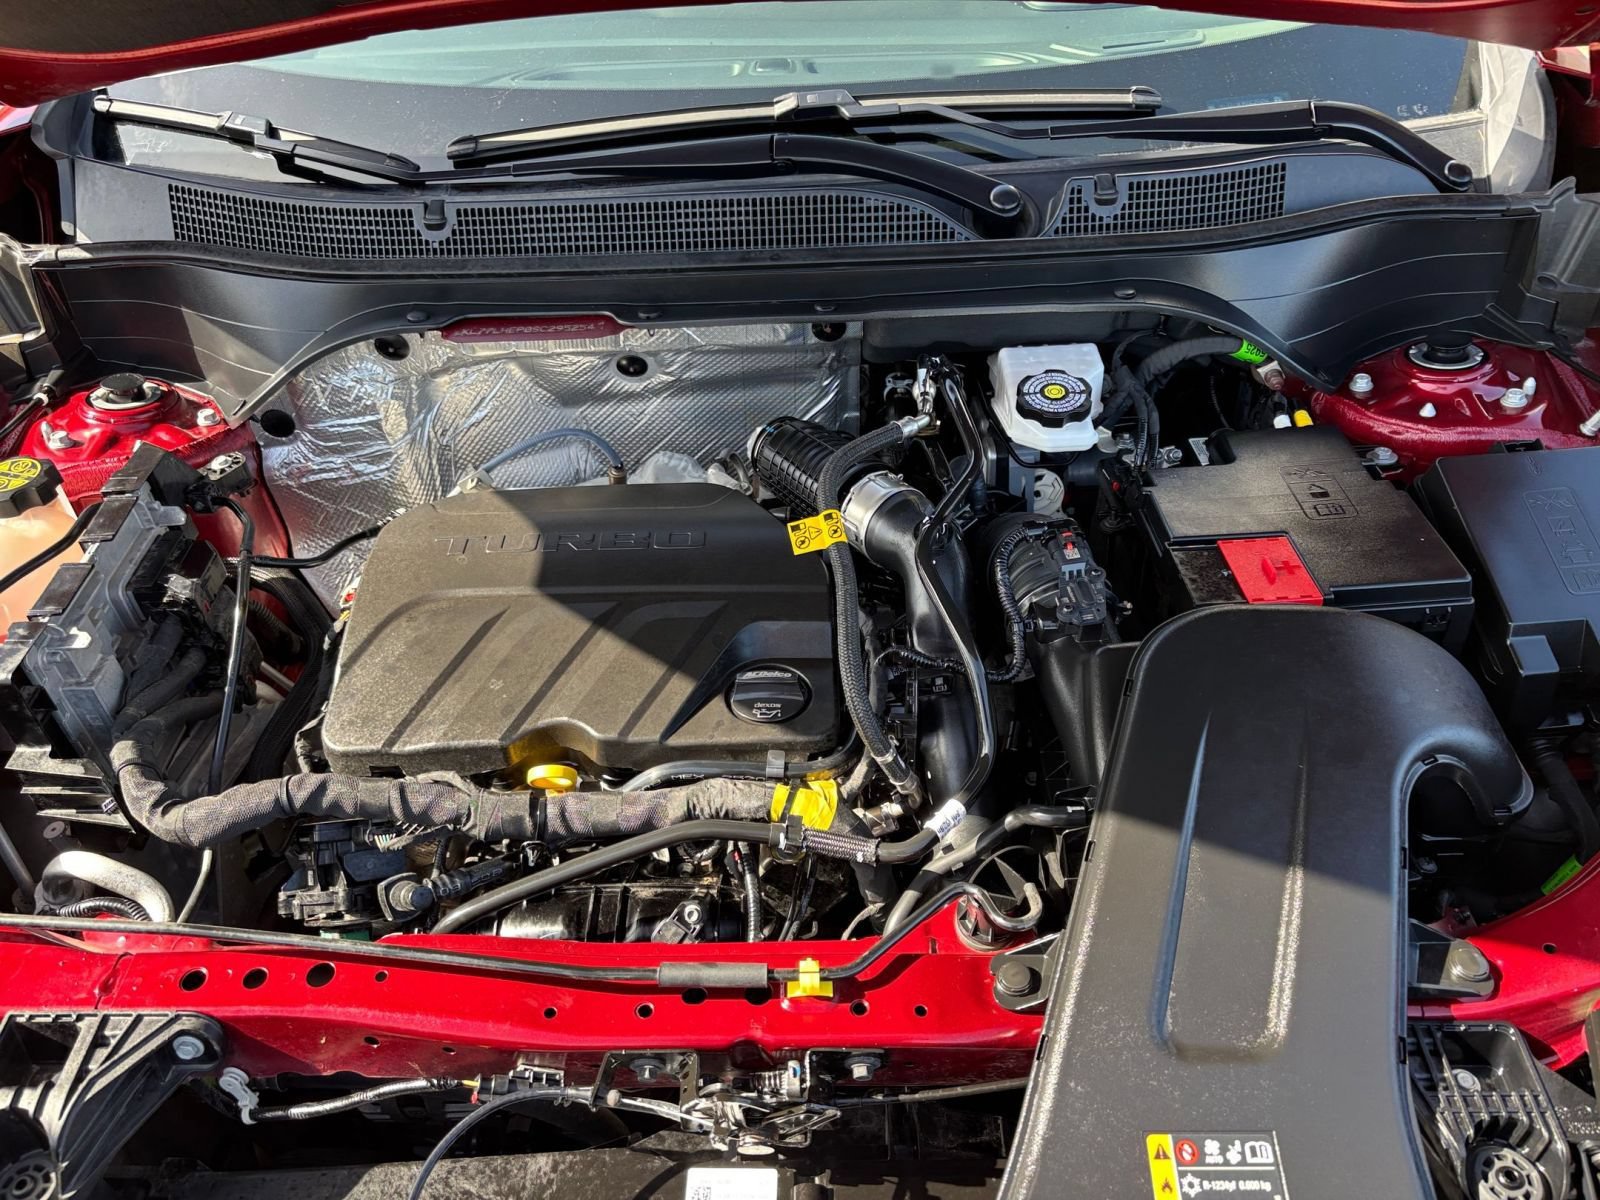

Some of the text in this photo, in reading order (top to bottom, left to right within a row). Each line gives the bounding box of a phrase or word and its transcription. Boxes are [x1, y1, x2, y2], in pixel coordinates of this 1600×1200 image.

[434, 531, 706, 555] TURBO
[741, 670, 793, 680] ACDelco
[1260, 1180, 1272, 1192] kg
